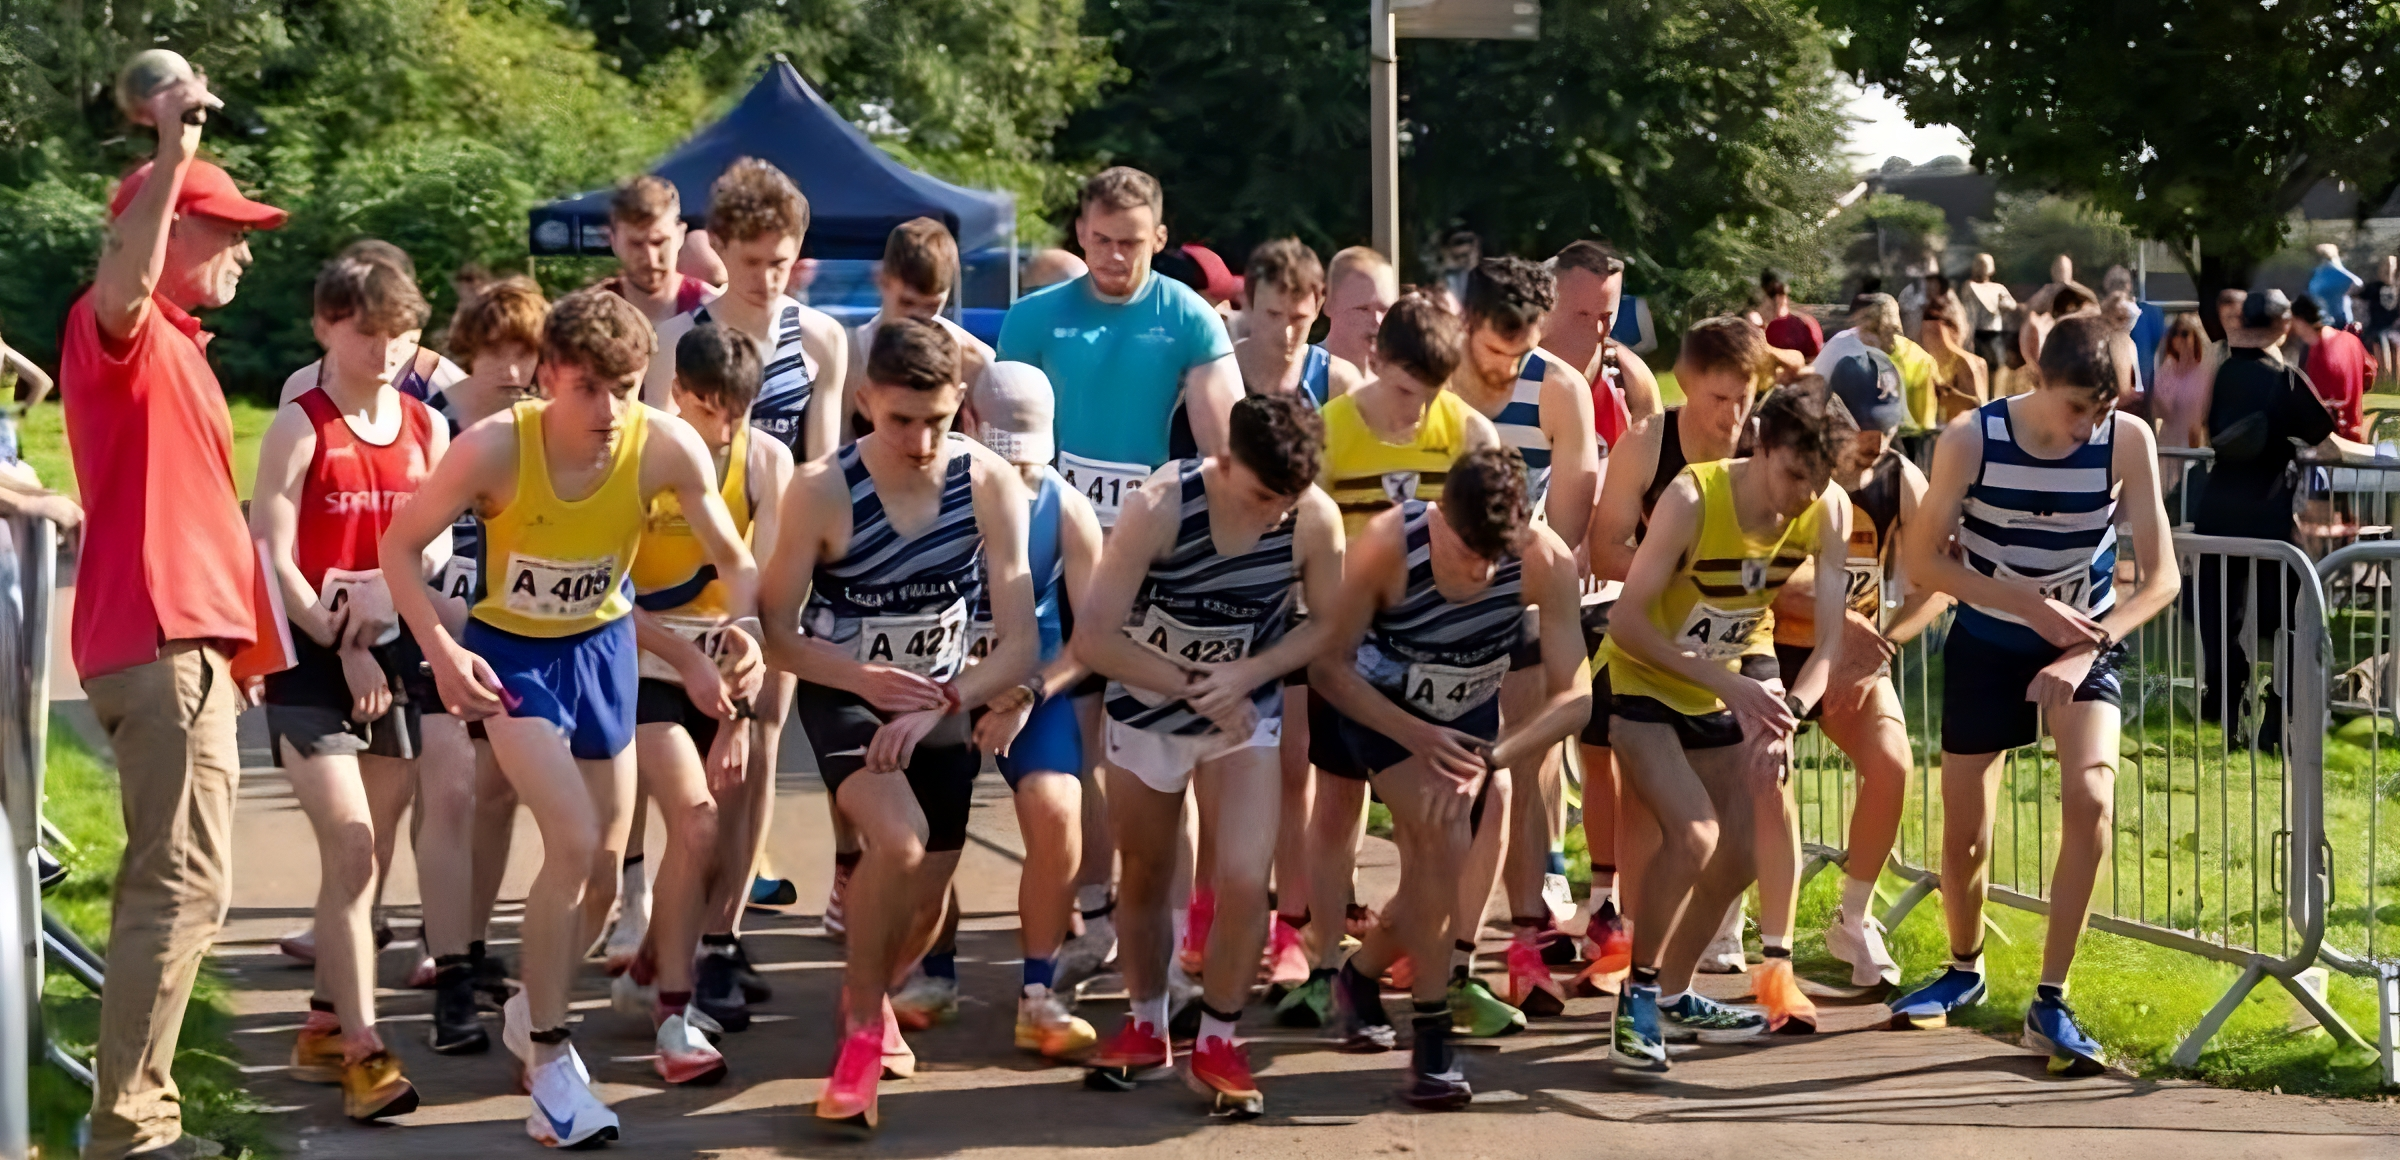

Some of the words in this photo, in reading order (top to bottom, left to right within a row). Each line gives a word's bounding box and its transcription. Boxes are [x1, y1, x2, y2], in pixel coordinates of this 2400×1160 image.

[512, 569, 536, 597] A
[1147, 626, 1168, 653] A
[1687, 617, 1711, 643] A
[869, 633, 893, 661] A
[1412, 678, 1434, 704] A
